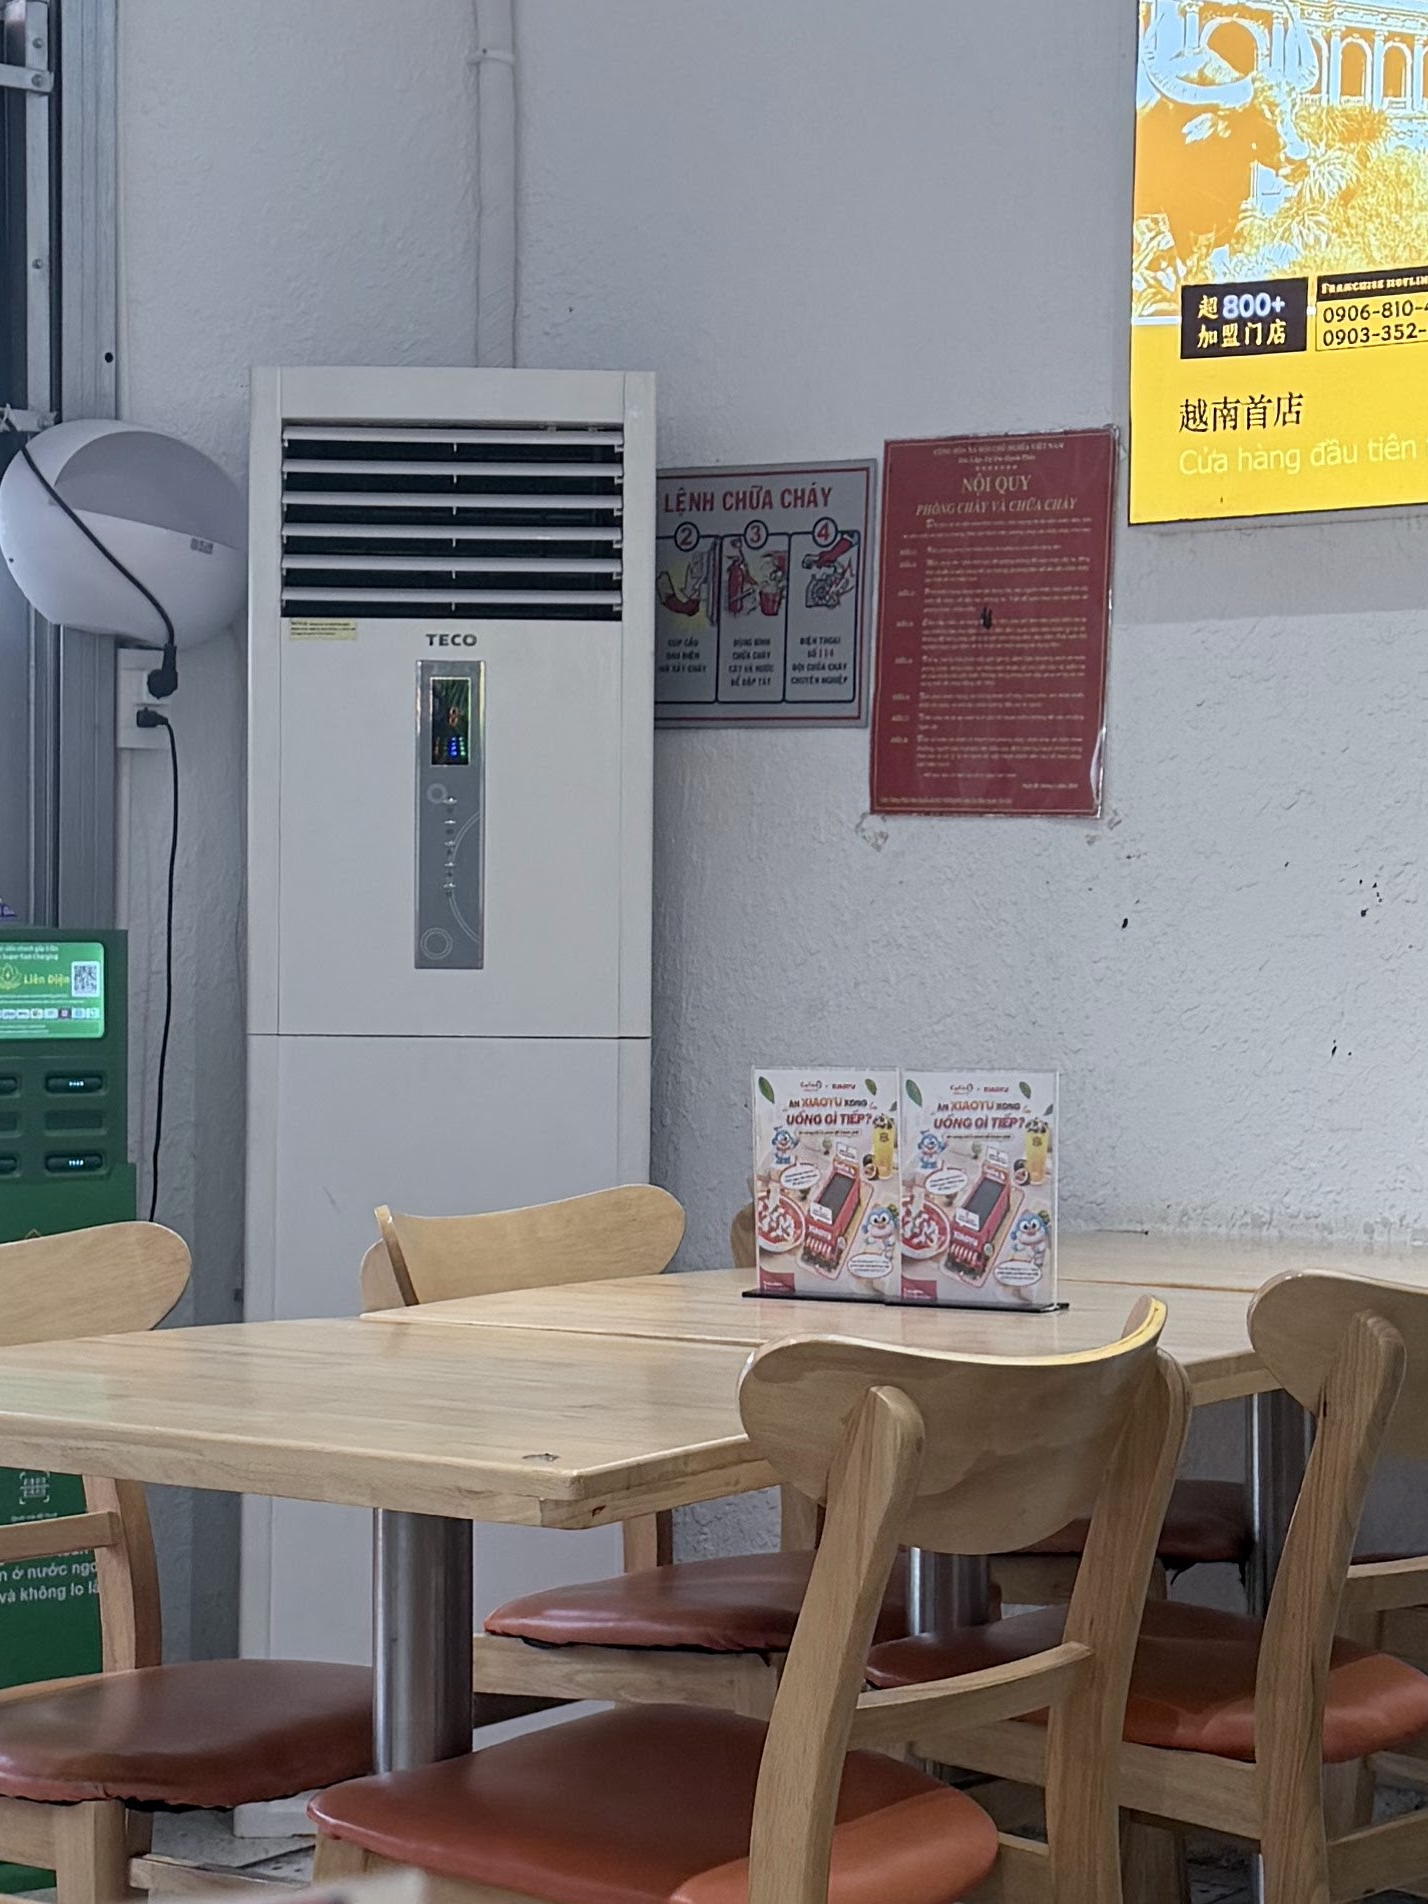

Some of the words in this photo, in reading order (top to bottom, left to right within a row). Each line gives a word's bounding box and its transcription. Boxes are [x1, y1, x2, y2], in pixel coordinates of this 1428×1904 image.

[1197, 318, 1287, 349] 加盟门店
[1178, 391, 1304, 434] 越南首店
[1178, 444, 1229, 477] Cửa
[1237, 443, 1301, 476] hàng
[1310, 437, 1358, 468] đầu
[1367, 432, 1417, 463] tiên
[961, 472, 991, 496] NỘI
[995, 474, 1032, 494] QUY
[664, 486, 715, 517] LỆNH
[722, 485, 774, 512] CHỮA
[780, 482, 832, 509] CHÁY
[916, 501, 956, 516] PHÒNG
[957, 499, 988, 514] CHÁY
[991, 499, 1007, 513] VÀ
[1009, 497, 1042, 512] CHỮA
[1044, 495, 1078, 511] CHÁY
[679, 526, 693, 546] 2
[749, 524, 762, 544] 3
[816, 522, 830, 541] 4
[426, 633, 478, 647] TECO
[27, 1562, 68, 1580] nước
[20, 1585, 67, 1602] không
[70, 1582, 84, 1596] lo
